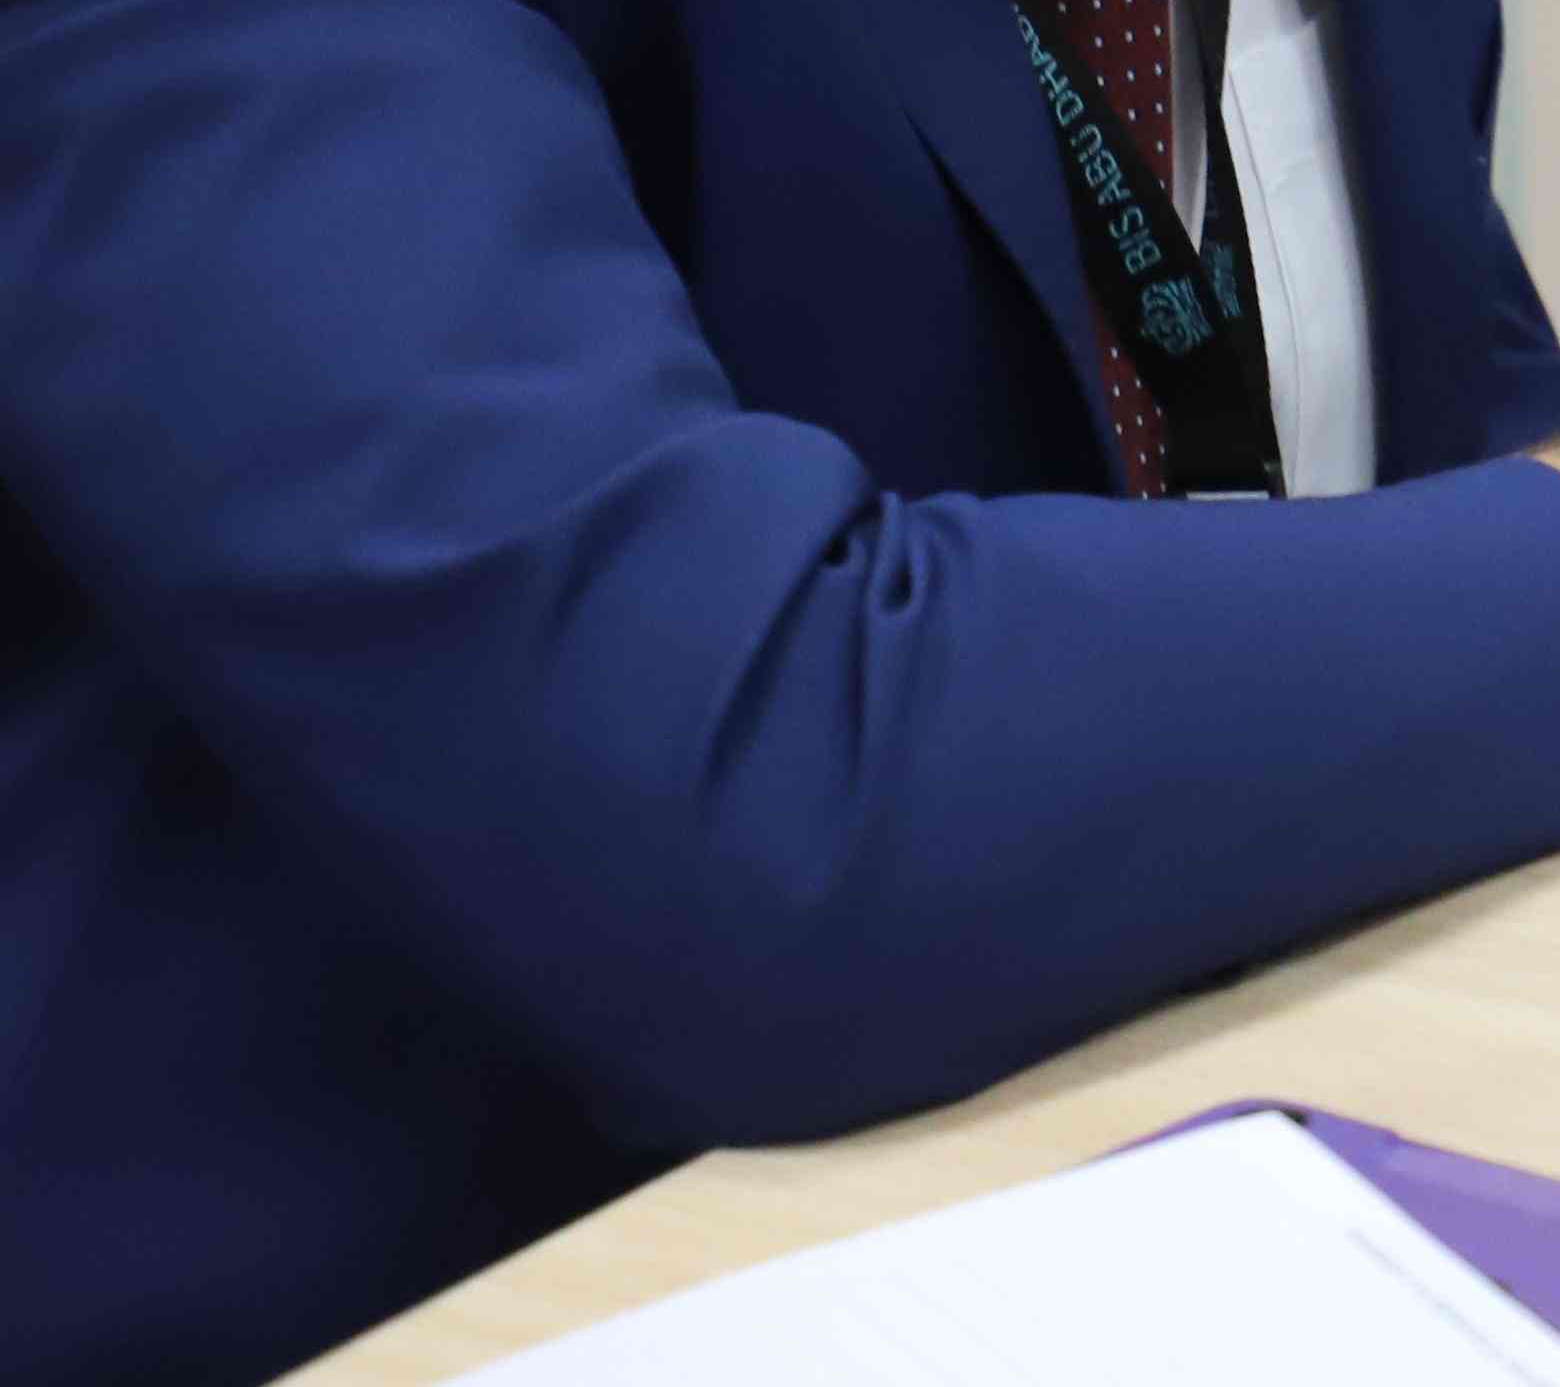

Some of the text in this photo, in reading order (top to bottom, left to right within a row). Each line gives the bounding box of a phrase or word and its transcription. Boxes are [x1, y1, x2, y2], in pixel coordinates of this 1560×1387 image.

[1012, 2, 1163, 275] BIS ABU DHAB
